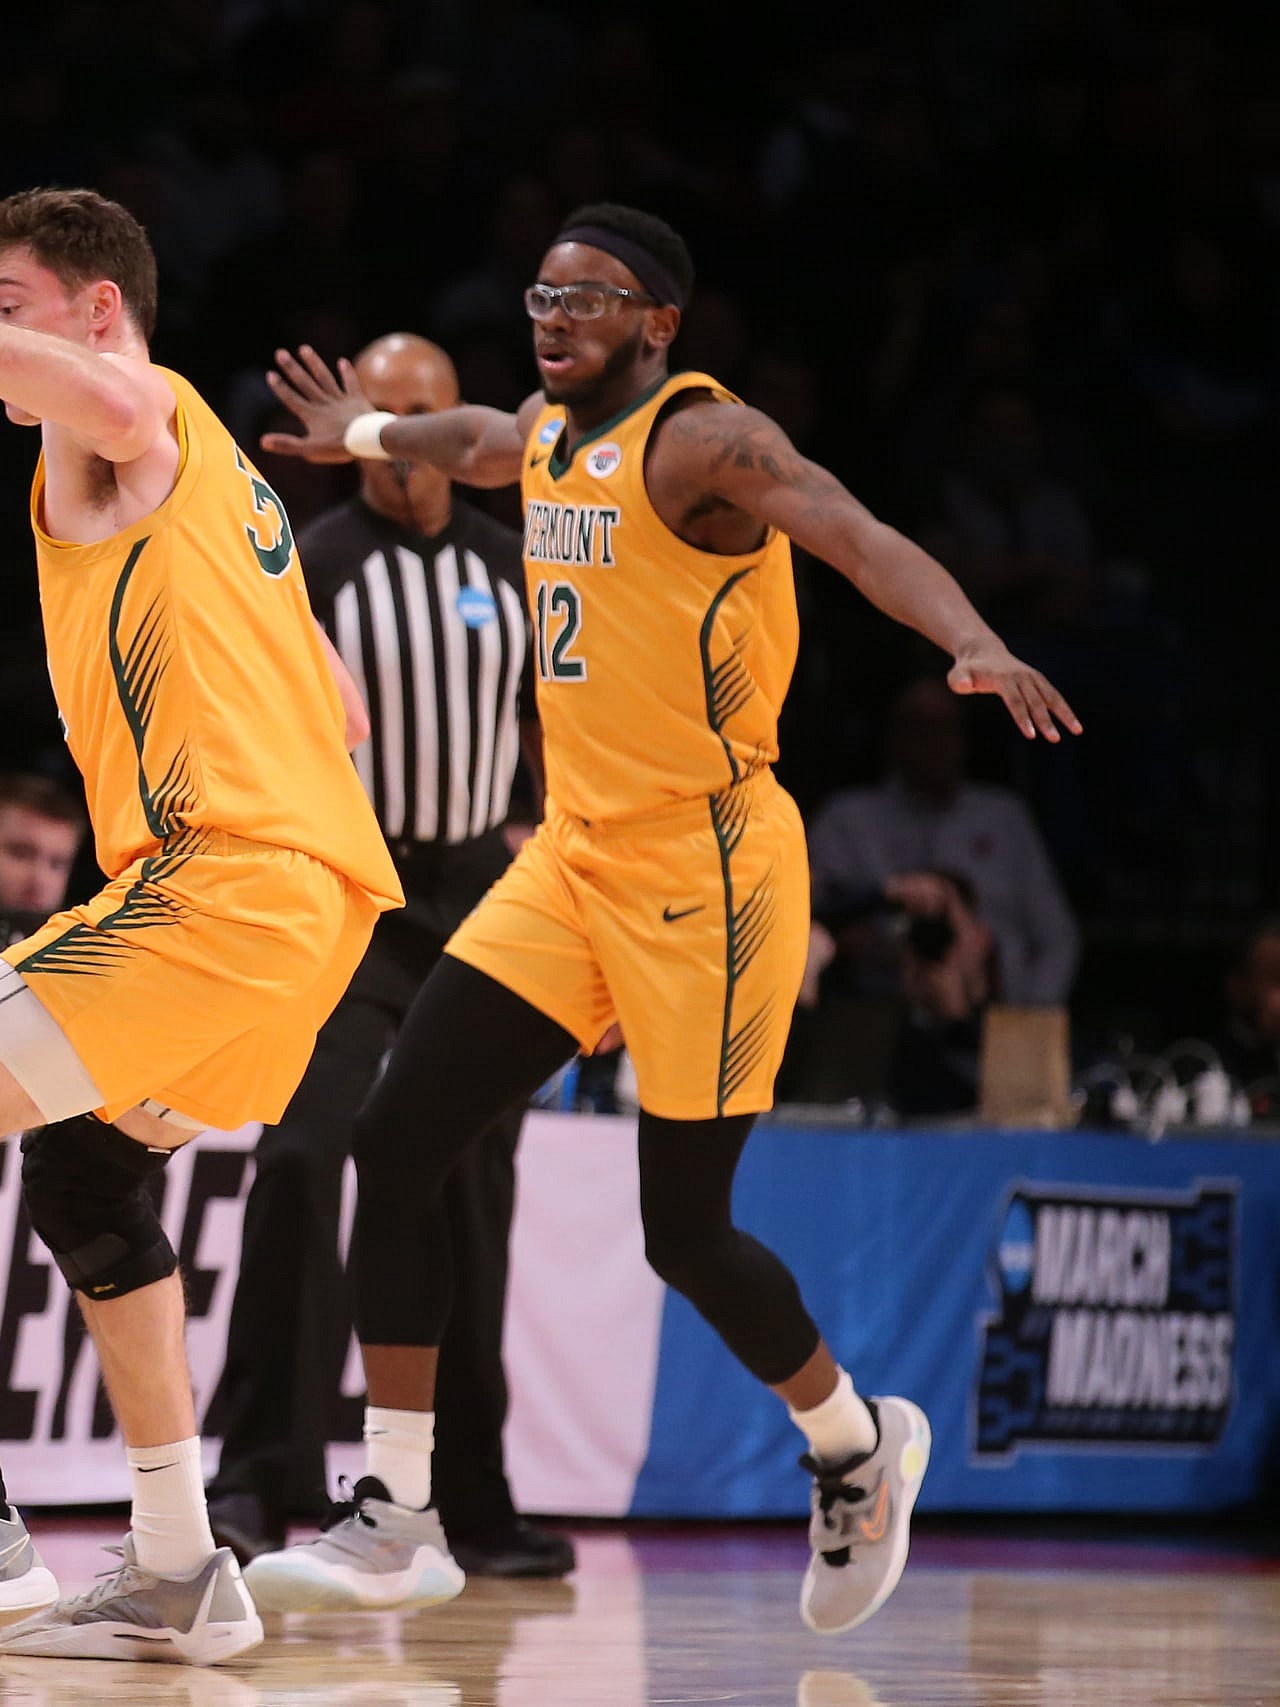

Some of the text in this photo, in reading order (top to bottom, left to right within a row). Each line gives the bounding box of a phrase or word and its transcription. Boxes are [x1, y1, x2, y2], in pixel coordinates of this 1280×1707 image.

[535, 580, 587, 683] 12
[1032, 1203, 1170, 1307] MARCH
[1044, 1307, 1234, 1410] MADNESS
